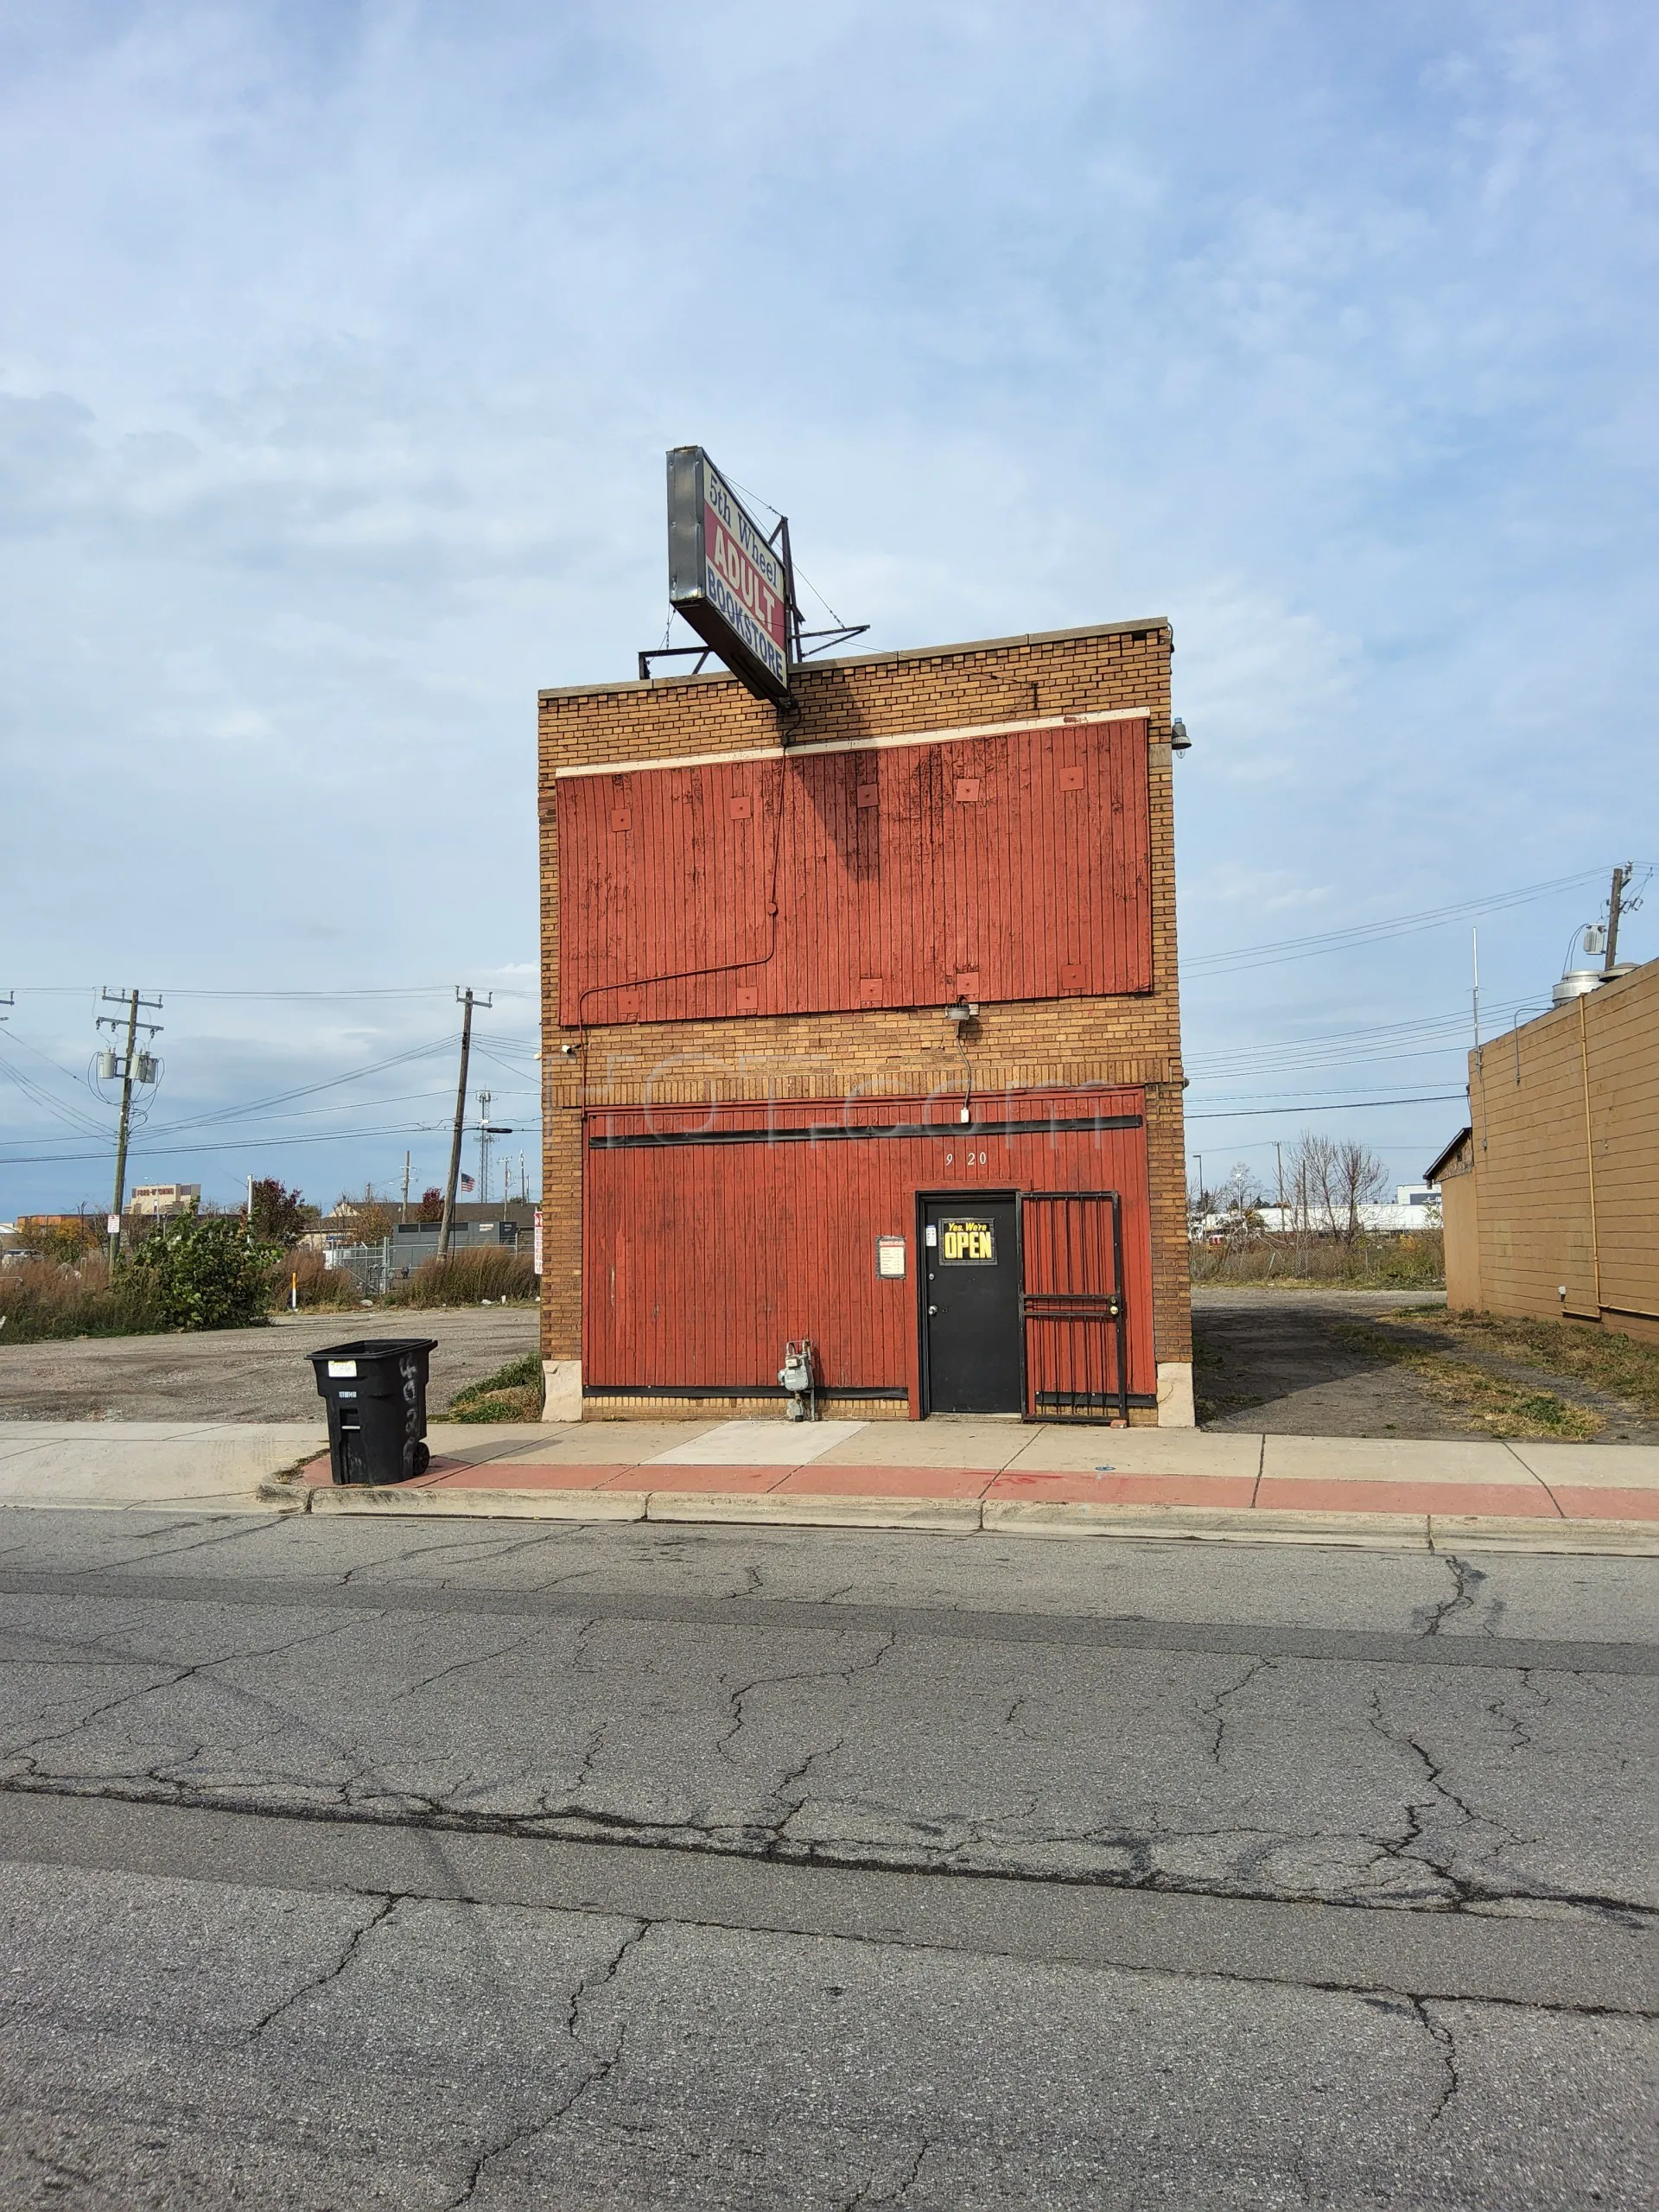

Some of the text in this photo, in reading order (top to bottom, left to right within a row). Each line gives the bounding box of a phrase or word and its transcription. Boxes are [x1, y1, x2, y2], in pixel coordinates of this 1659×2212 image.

[709, 472, 778, 589] 5th Wheel
[714, 524, 775, 634] ADULT
[706, 563, 784, 683] BOOKSTORE
[944, 1231, 992, 1259] OPEN
